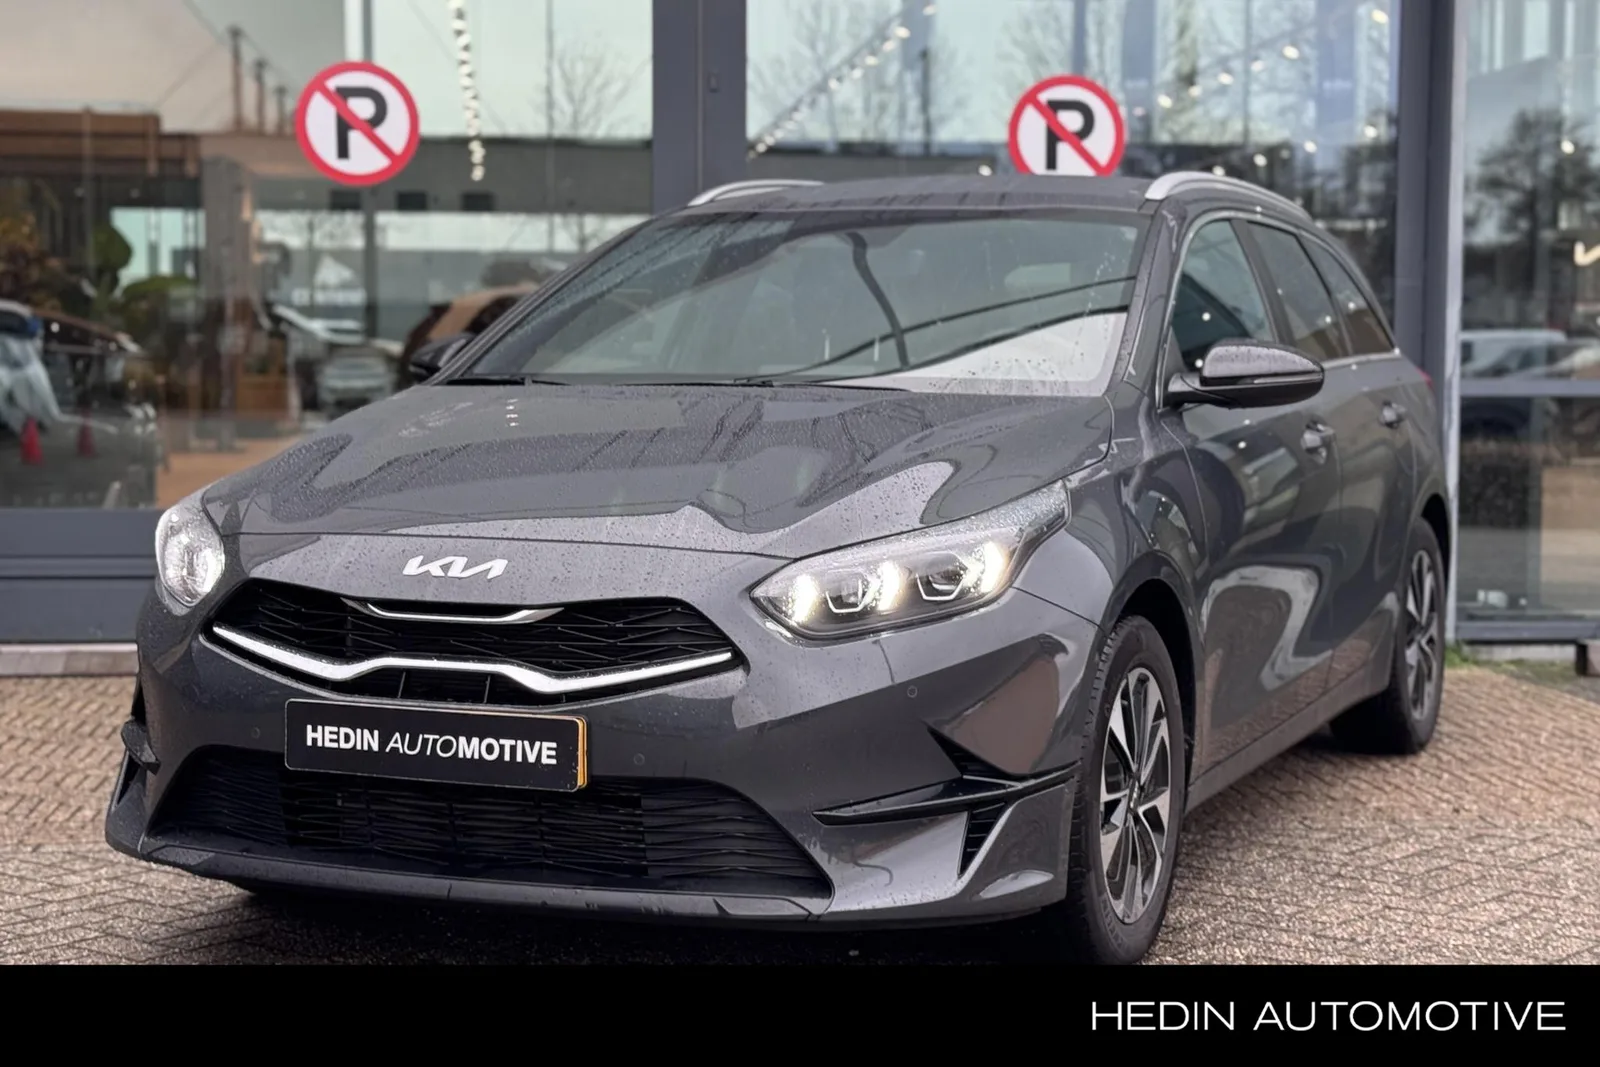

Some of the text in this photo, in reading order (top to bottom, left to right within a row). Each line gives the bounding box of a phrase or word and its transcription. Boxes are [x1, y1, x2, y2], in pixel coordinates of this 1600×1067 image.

[335, 86, 388, 159] P
[1045, 100, 1094, 170] P
[306, 724, 558, 765] HEDIN AUTOMOTIVE
